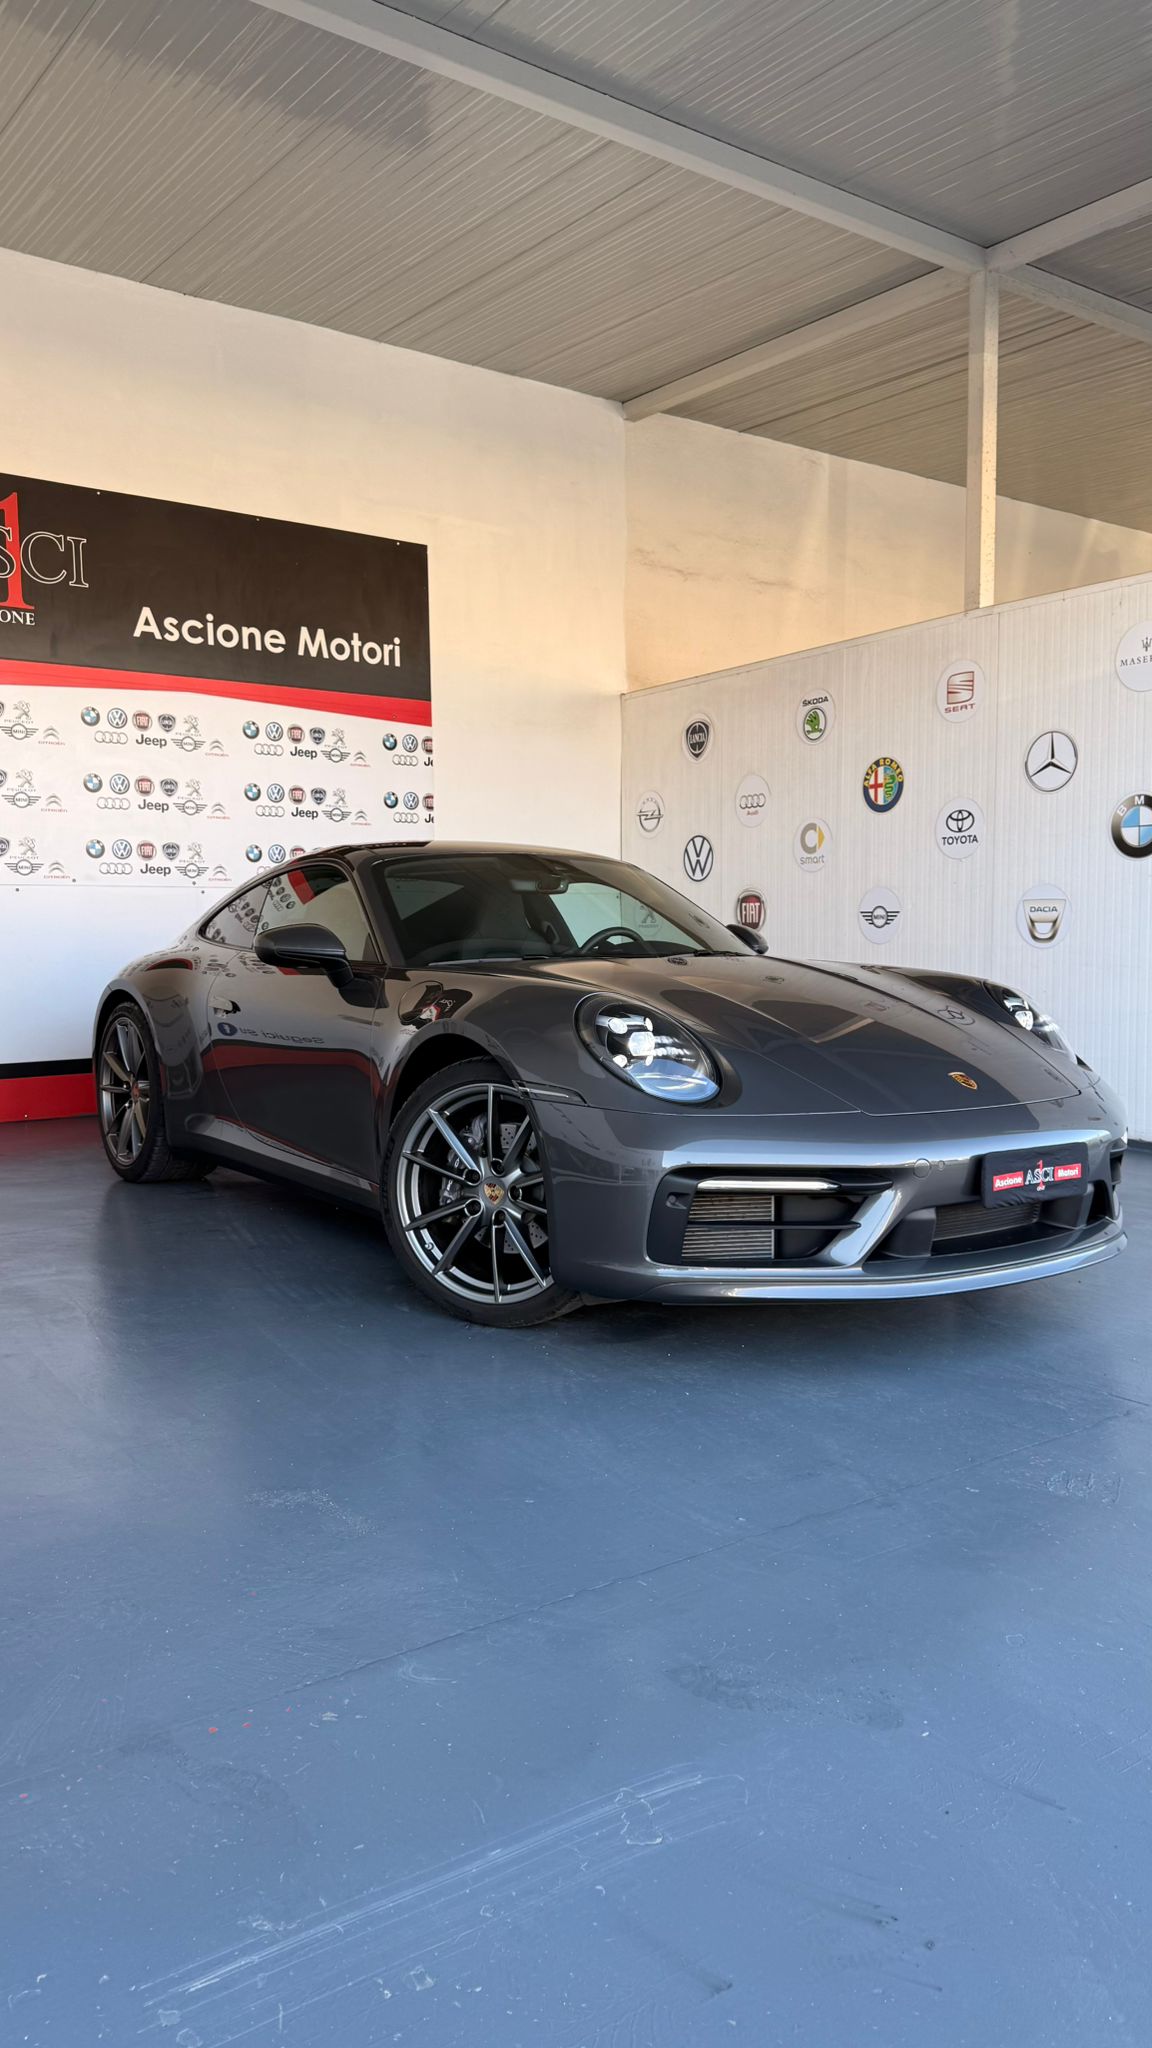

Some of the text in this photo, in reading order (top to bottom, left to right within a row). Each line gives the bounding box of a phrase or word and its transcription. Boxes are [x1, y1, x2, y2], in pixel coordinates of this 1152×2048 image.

[133, 606, 401, 668] Ascione Motori
[1120, 654, 1152, 667] MASE
[802, 696, 829, 707] ŠKODA
[944, 703, 976, 713] SEAT
[135, 733, 168, 749] Jeep
[689, 732, 706, 744] LANCIA
[290, 746, 318, 760] Jeep
[879, 757, 903, 782] ROMEO
[138, 799, 170, 814] Jeep
[291, 806, 319, 820] Jeep
[942, 834, 979, 846] TOYOTA
[800, 854, 825, 865] smart
[140, 863, 172, 877] Jeep
[741, 902, 761, 924] FIAT
[1029, 905, 1058, 913] DACIA
[995, 1176, 1022, 1188] Ascione
[1025, 1167, 1054, 1185] ASCI
[1057, 1167, 1079, 1178] Motori
